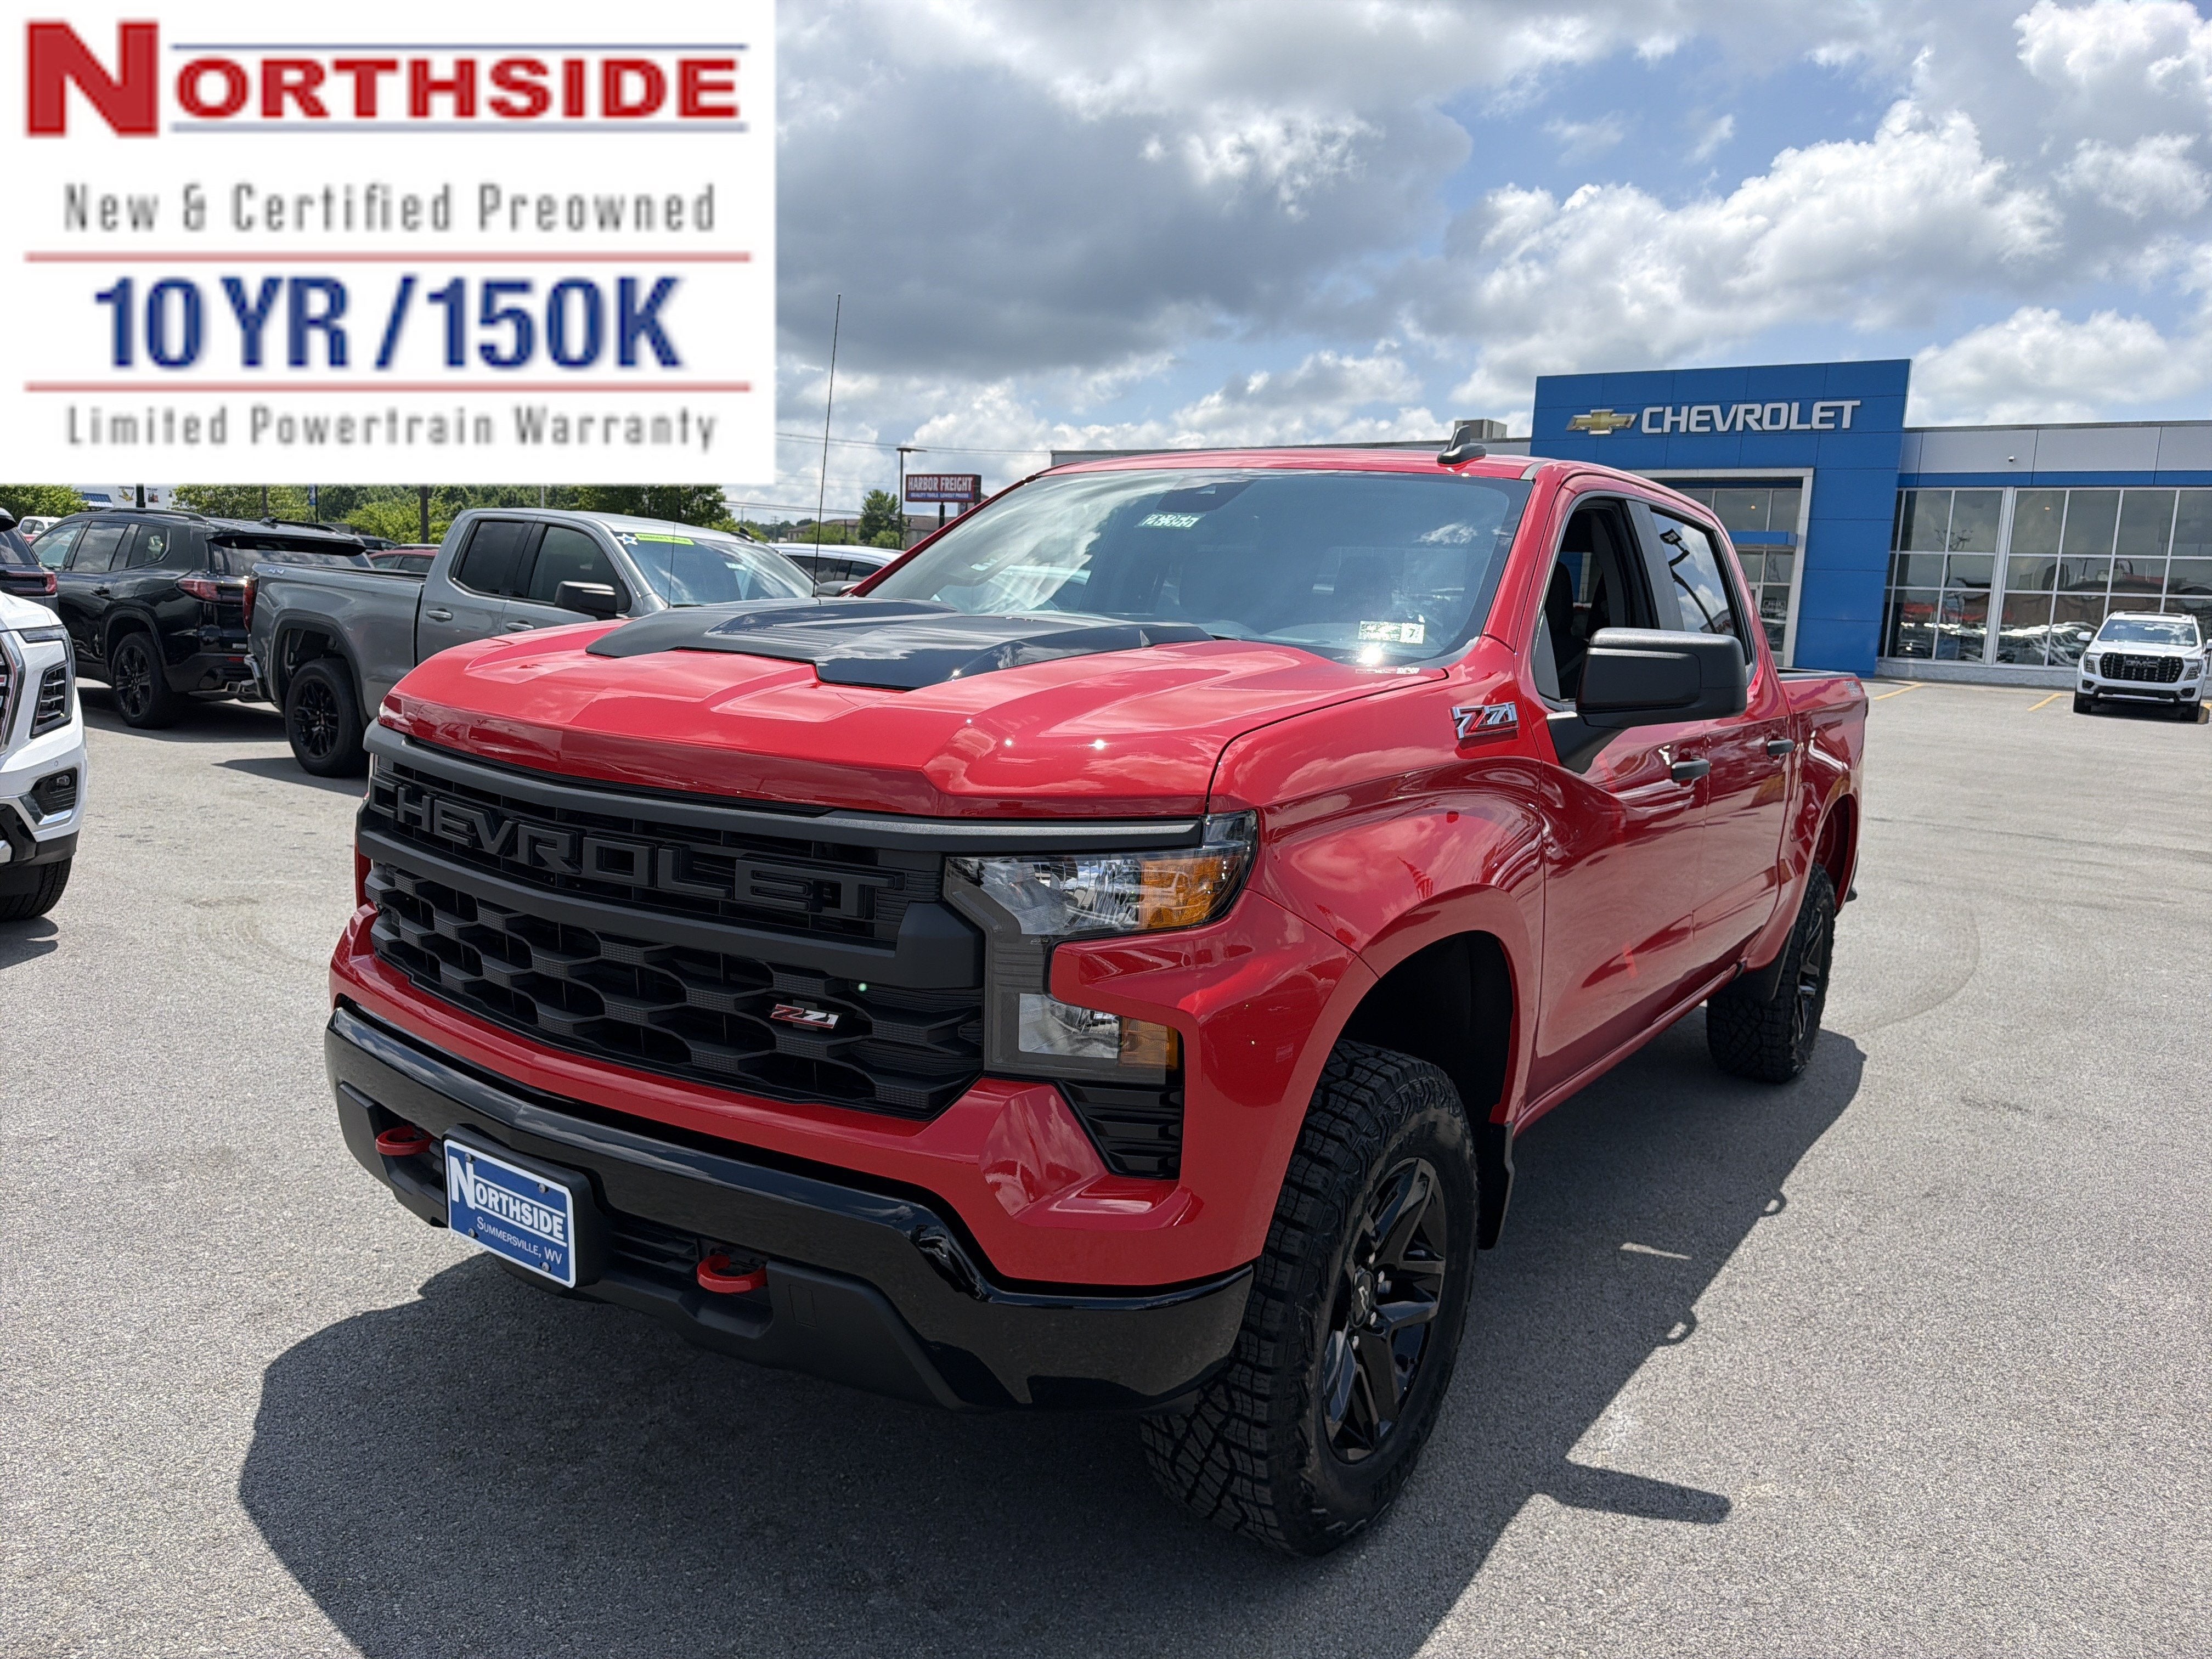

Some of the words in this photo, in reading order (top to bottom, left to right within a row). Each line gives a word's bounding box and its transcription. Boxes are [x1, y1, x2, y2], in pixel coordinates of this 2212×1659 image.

[1641, 400, 1861, 433] CHEVROLET
[908, 476, 938, 492] HARBOR
[940, 476, 973, 492] FREIGHT
[1451, 702, 1519, 740] Z71
[369, 771, 906, 918] CHEVROLET
[770, 1003, 839, 1029] Z71
[449, 1155, 565, 1240] NORTHSIDE
[476, 1216, 542, 1259] SUMMERSVILLE,
[544, 1246, 562, 1265] WV
